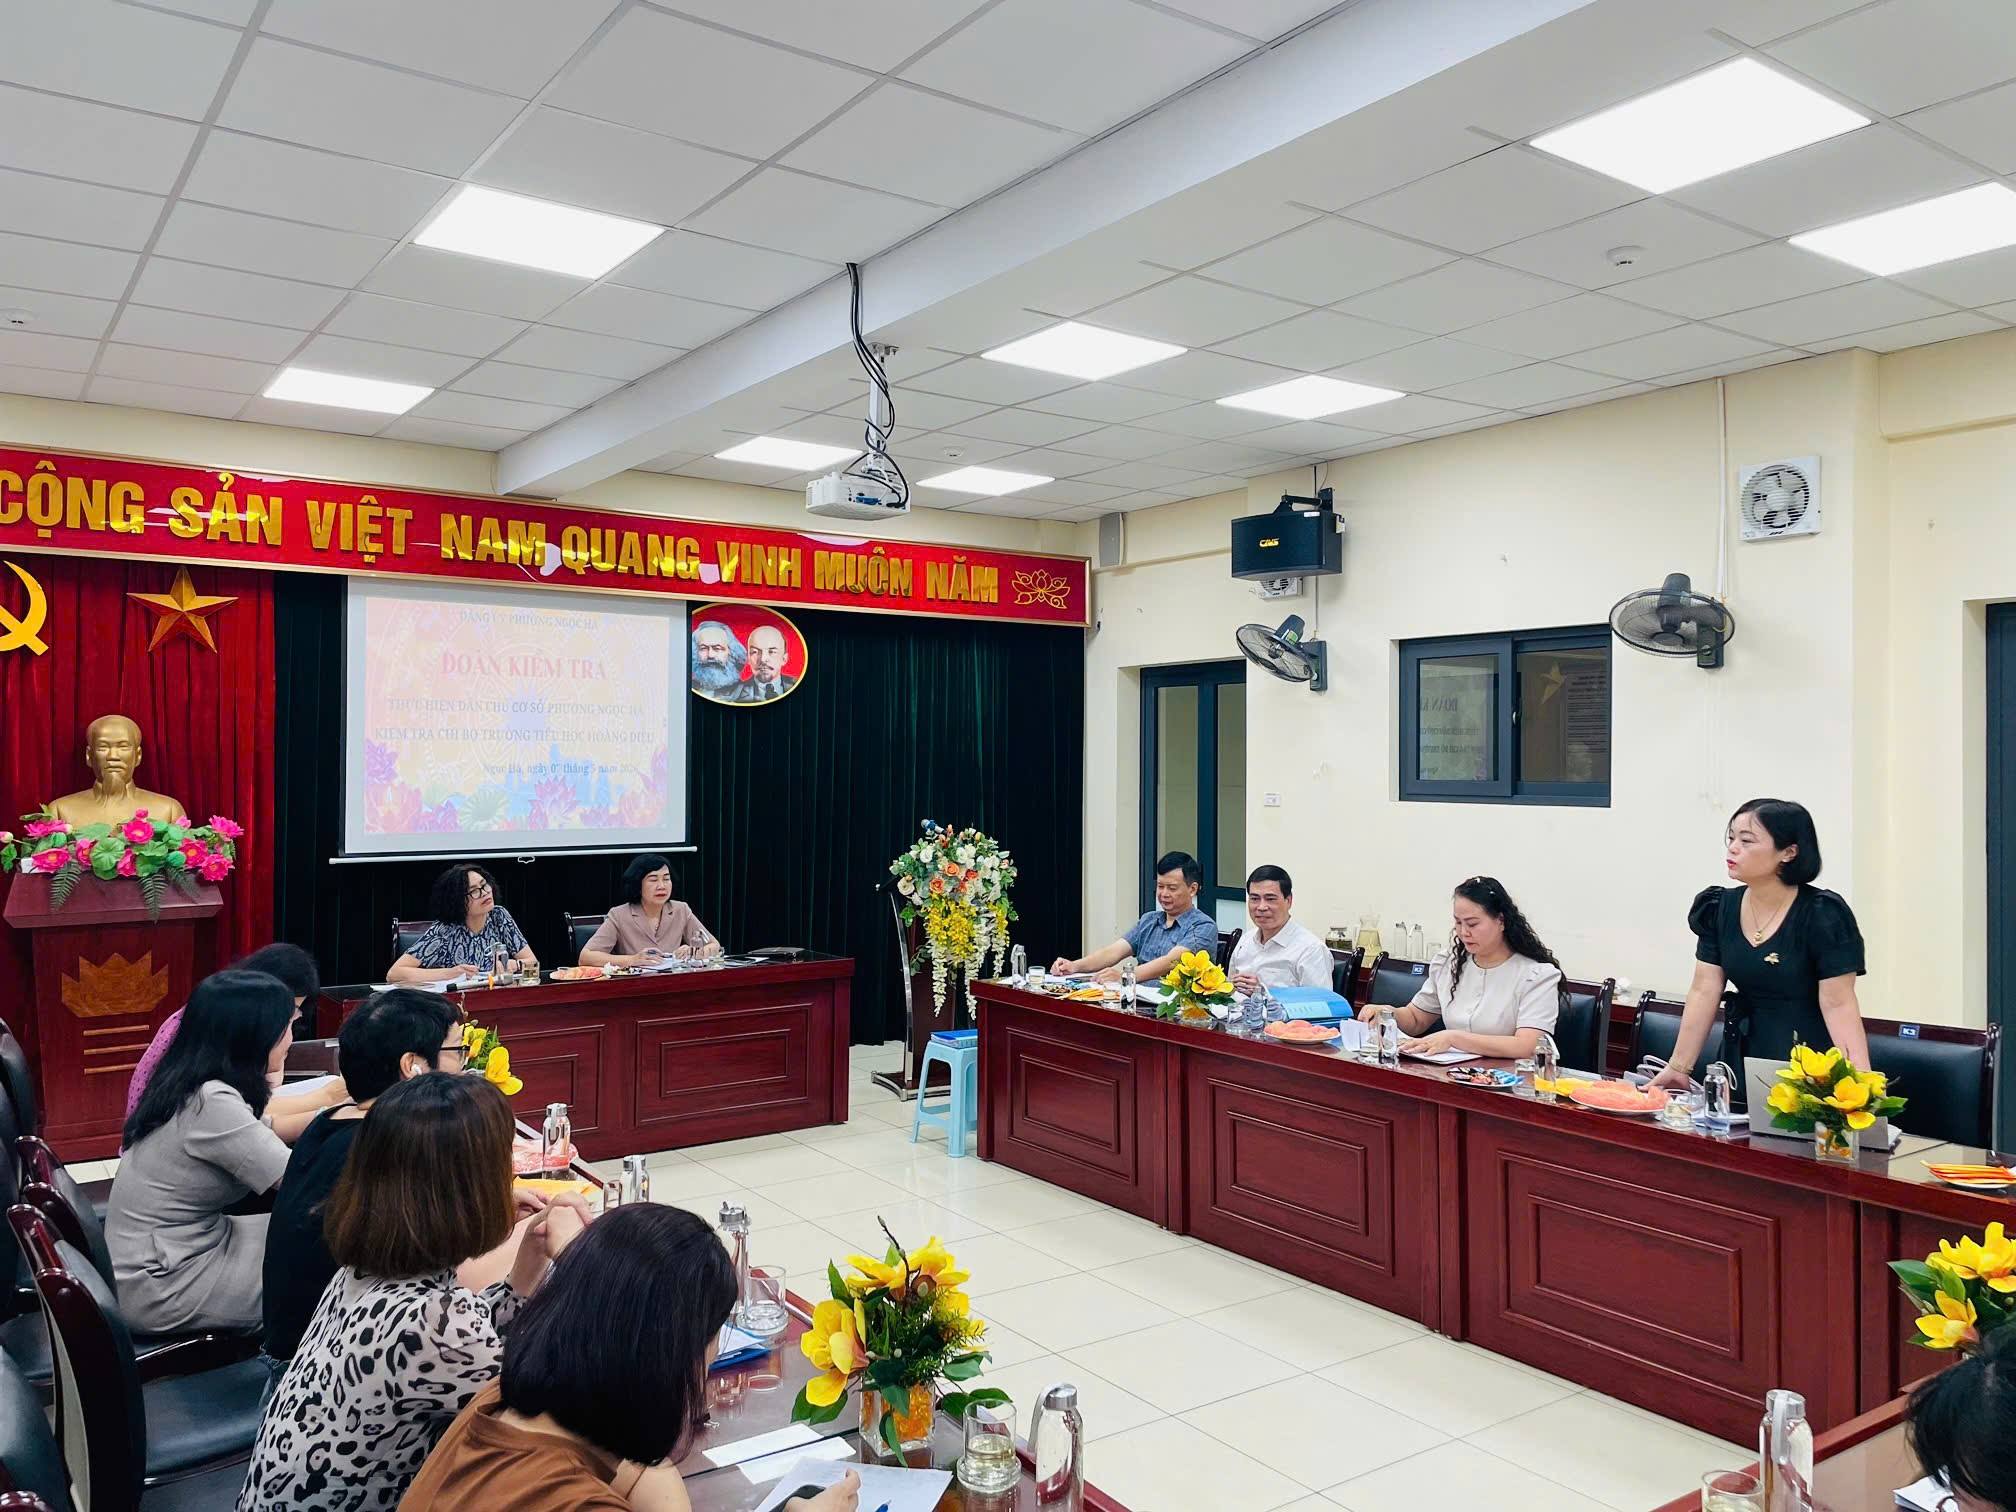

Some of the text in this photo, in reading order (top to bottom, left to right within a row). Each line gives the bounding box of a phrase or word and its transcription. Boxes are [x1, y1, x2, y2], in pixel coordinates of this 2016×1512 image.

[0, 460, 999, 603] CỘNG SẢN VIỆT NAM QUANG VINH MUÔN NĂM
[440, 648, 608, 680] ĐOÀN KIỂM TRA
